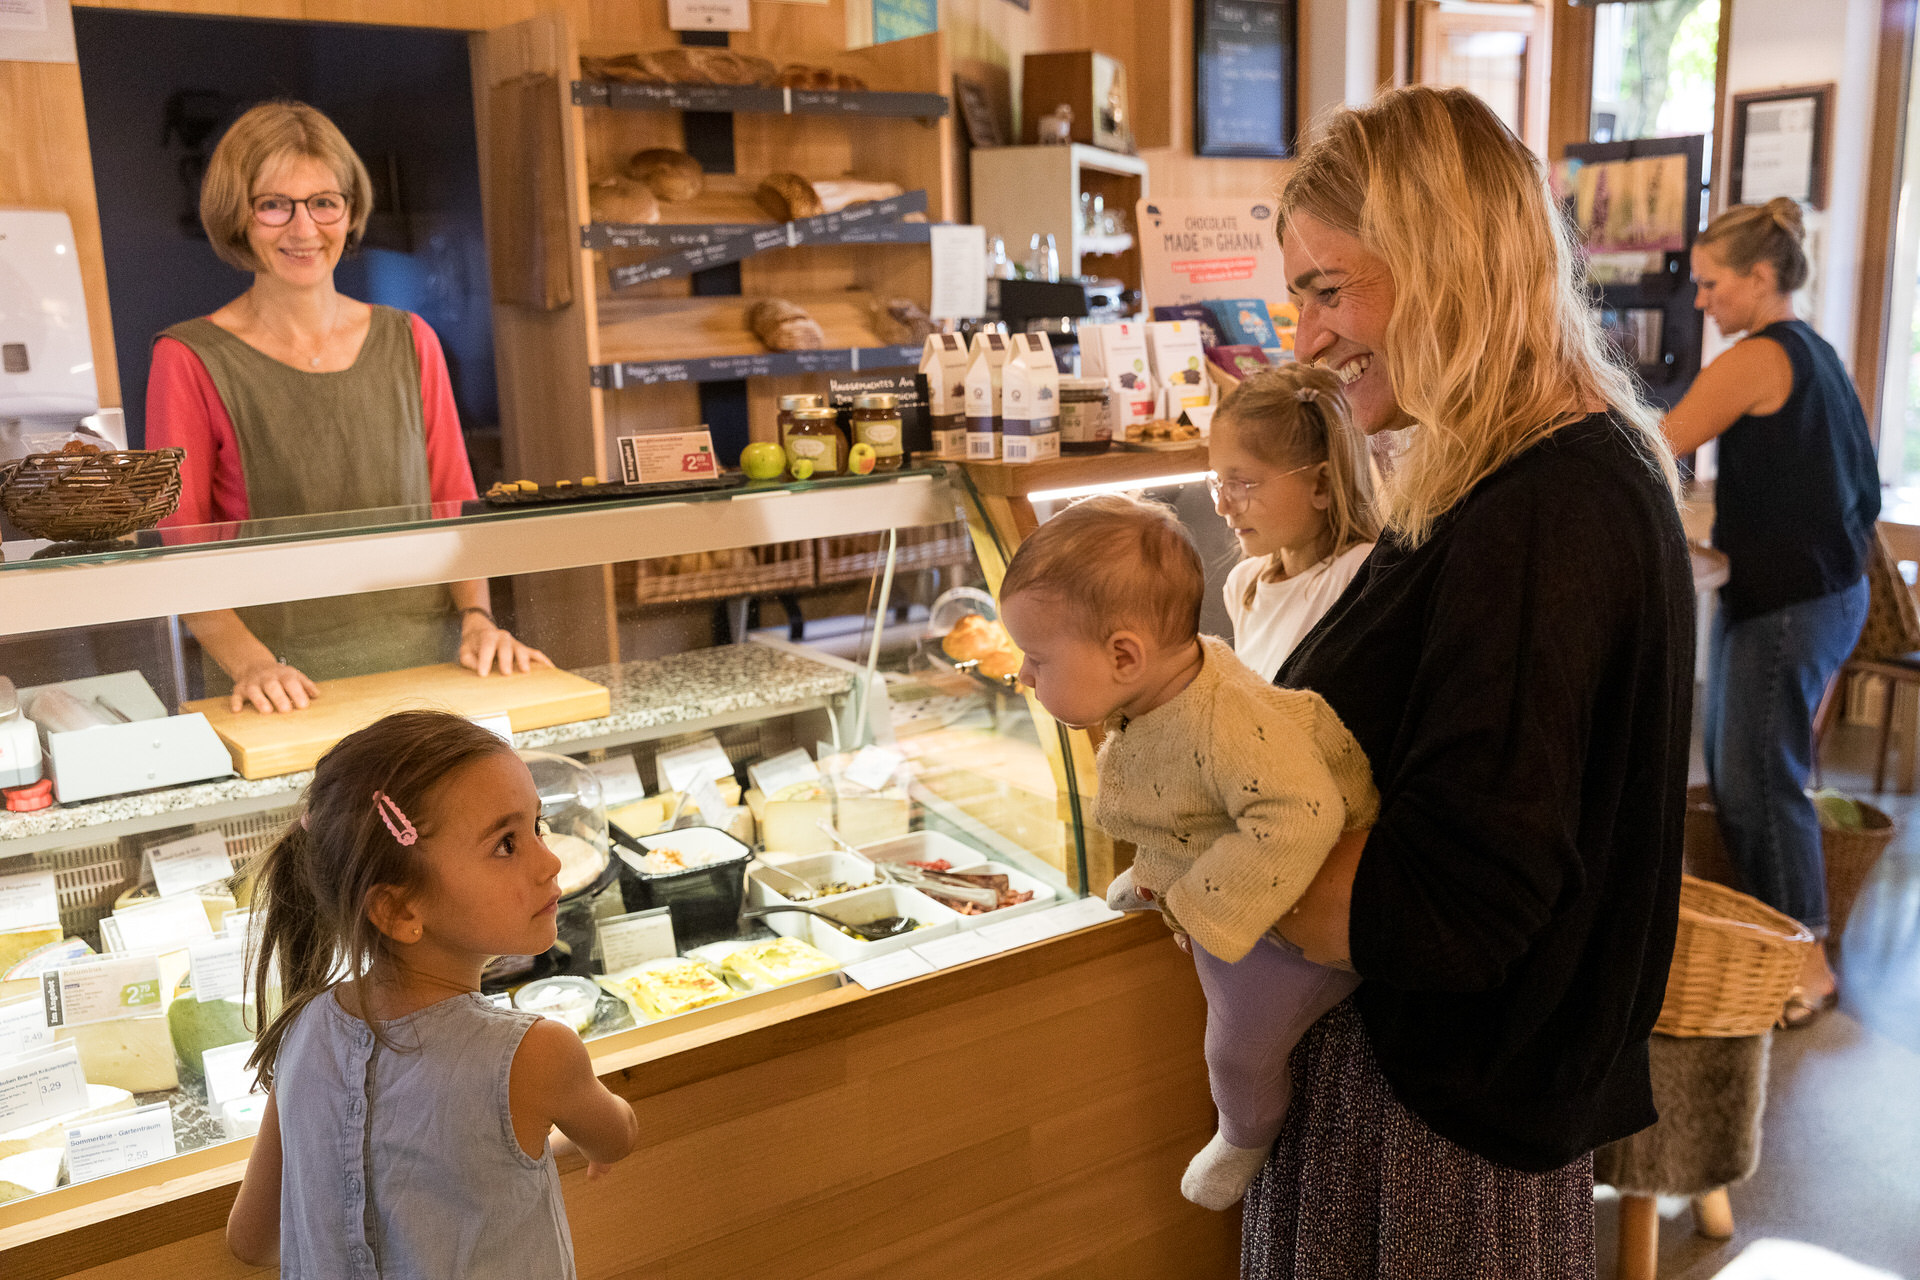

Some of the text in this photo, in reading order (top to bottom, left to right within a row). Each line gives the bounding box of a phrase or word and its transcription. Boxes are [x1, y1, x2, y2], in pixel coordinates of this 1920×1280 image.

[1184, 215, 1238, 231] CHOCOLATE
[1164, 233, 1199, 252] MADE
[1216, 232, 1263, 251] GHANA
[686, 455, 699, 471] 2
[47, 980, 59, 1024] Im Angebot
[126, 986, 140, 1004] 2
[24, 1031, 43, 1044] 2,49
[41, 1080, 62, 1094] 3,29
[70, 1132, 113, 1147] Sommerbrie
[118, 1122, 161, 1137] Gartentraum
[127, 1150, 149, 1162] 2,59
